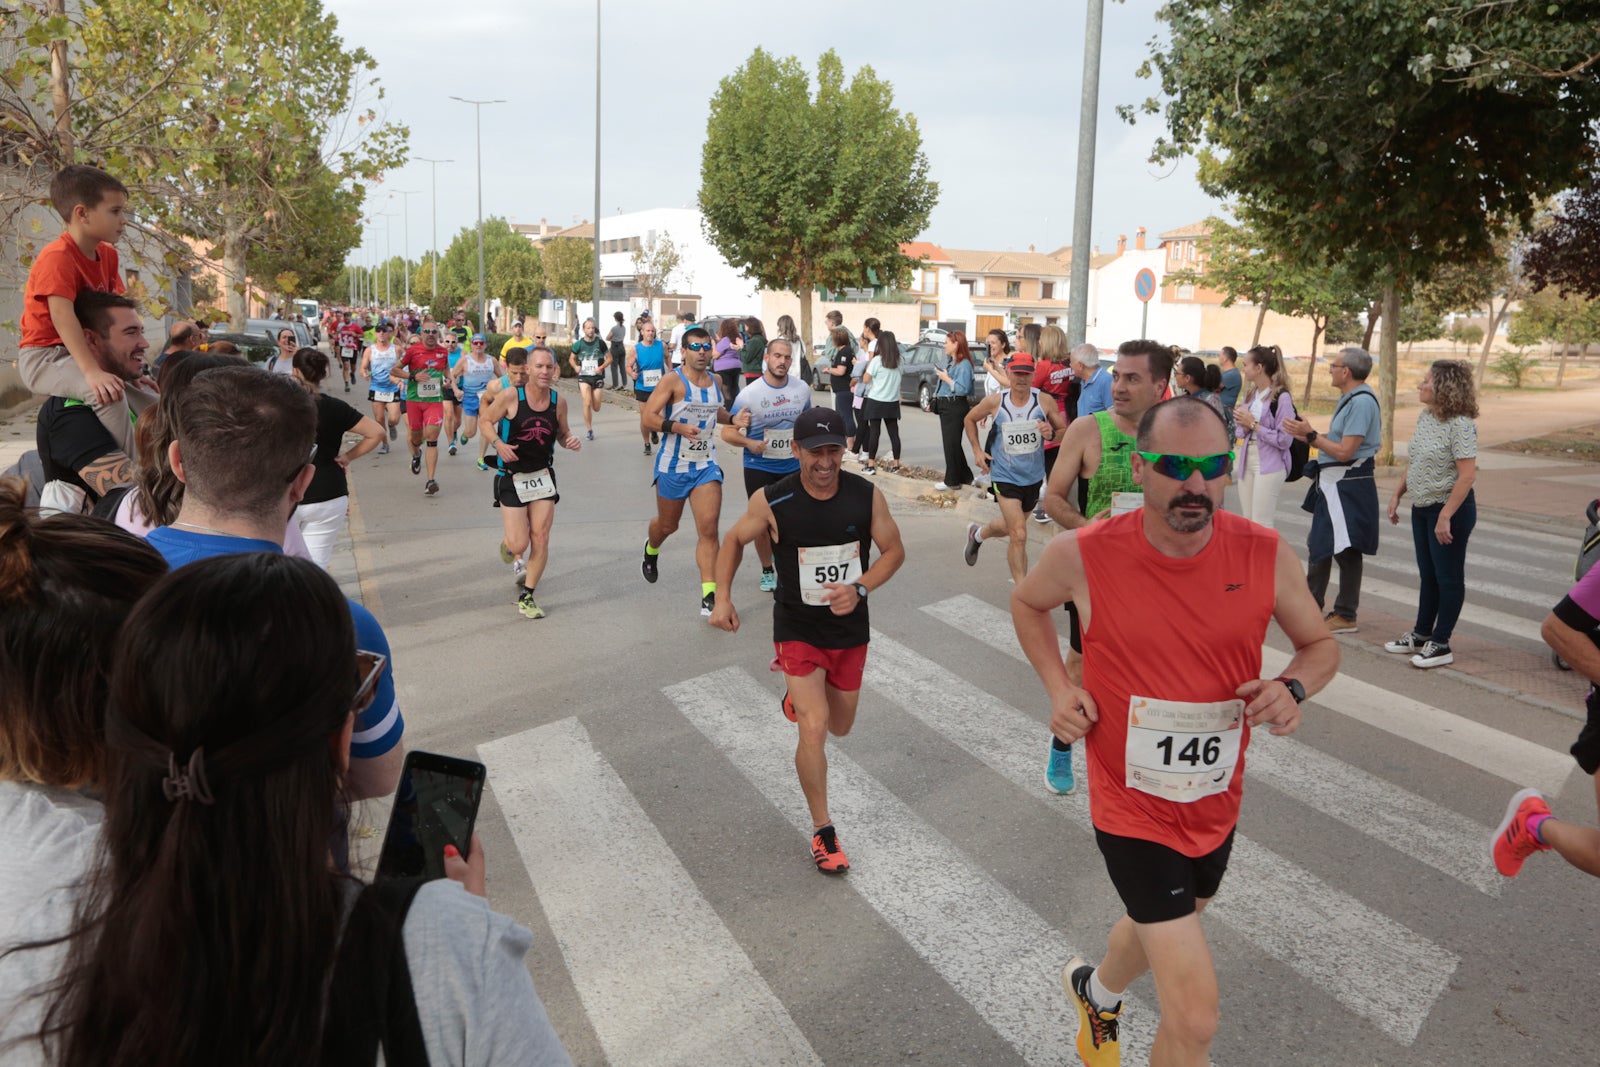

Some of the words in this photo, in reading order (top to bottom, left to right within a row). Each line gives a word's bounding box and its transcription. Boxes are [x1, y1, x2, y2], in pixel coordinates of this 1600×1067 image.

[555, 300, 562, 309] P
[764, 409, 801, 418] MARACEN
[771, 439, 790, 449] 601
[1007, 432, 1037, 446] 3083
[688, 440, 708, 451] 228
[522, 477, 544, 490] 701
[815, 562, 849, 584] 597
[1156, 735, 1222, 767] 146
